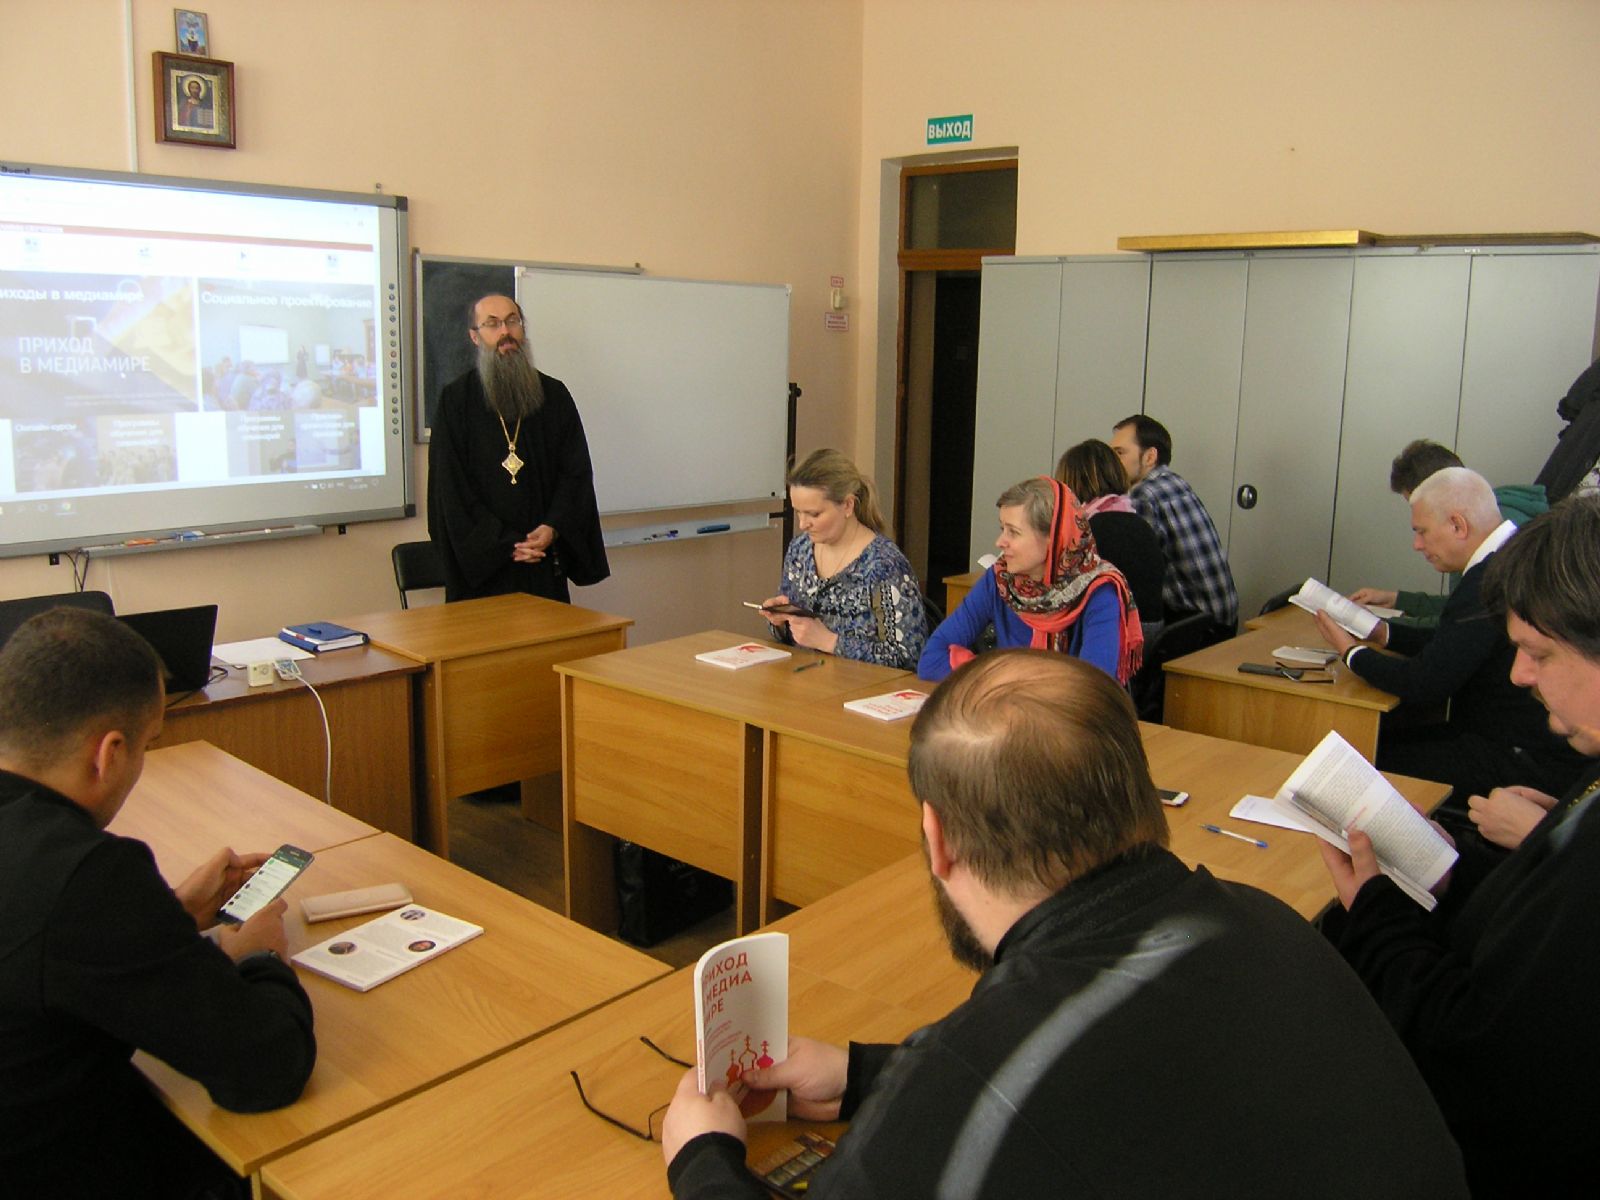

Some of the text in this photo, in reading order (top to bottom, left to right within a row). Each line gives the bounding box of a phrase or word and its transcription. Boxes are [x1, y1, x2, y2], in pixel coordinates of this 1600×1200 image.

[928, 120, 971, 139] ВЫХОД
[18, 336, 95, 355] ПРИХОД
[20, 355, 152, 376] В МЕДИАМИРЕ
